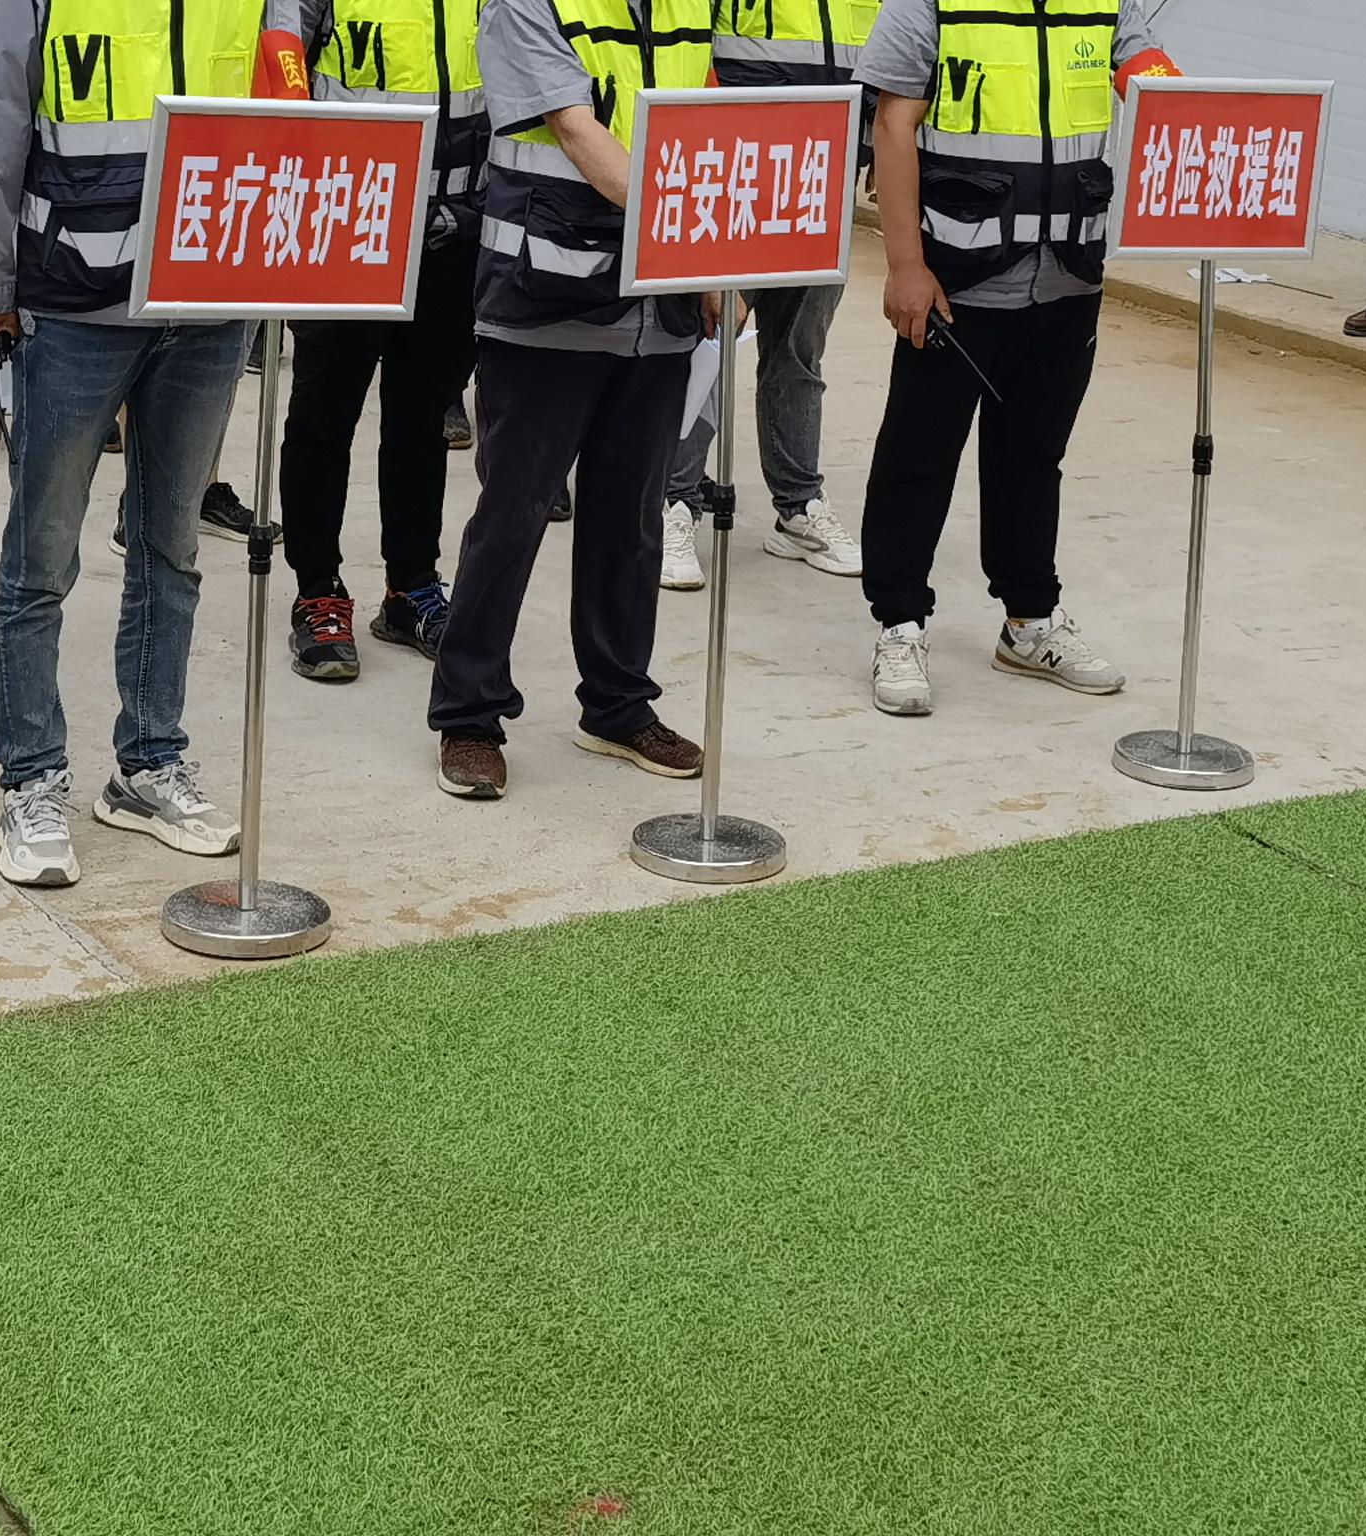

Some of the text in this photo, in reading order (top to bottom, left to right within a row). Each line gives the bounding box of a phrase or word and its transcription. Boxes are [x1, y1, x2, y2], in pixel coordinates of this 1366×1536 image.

[169, 151, 398, 268] 医疗救护组
[651, 135, 831, 245] 治安保卫组
[1137, 123, 1305, 220] 抢险救援组
